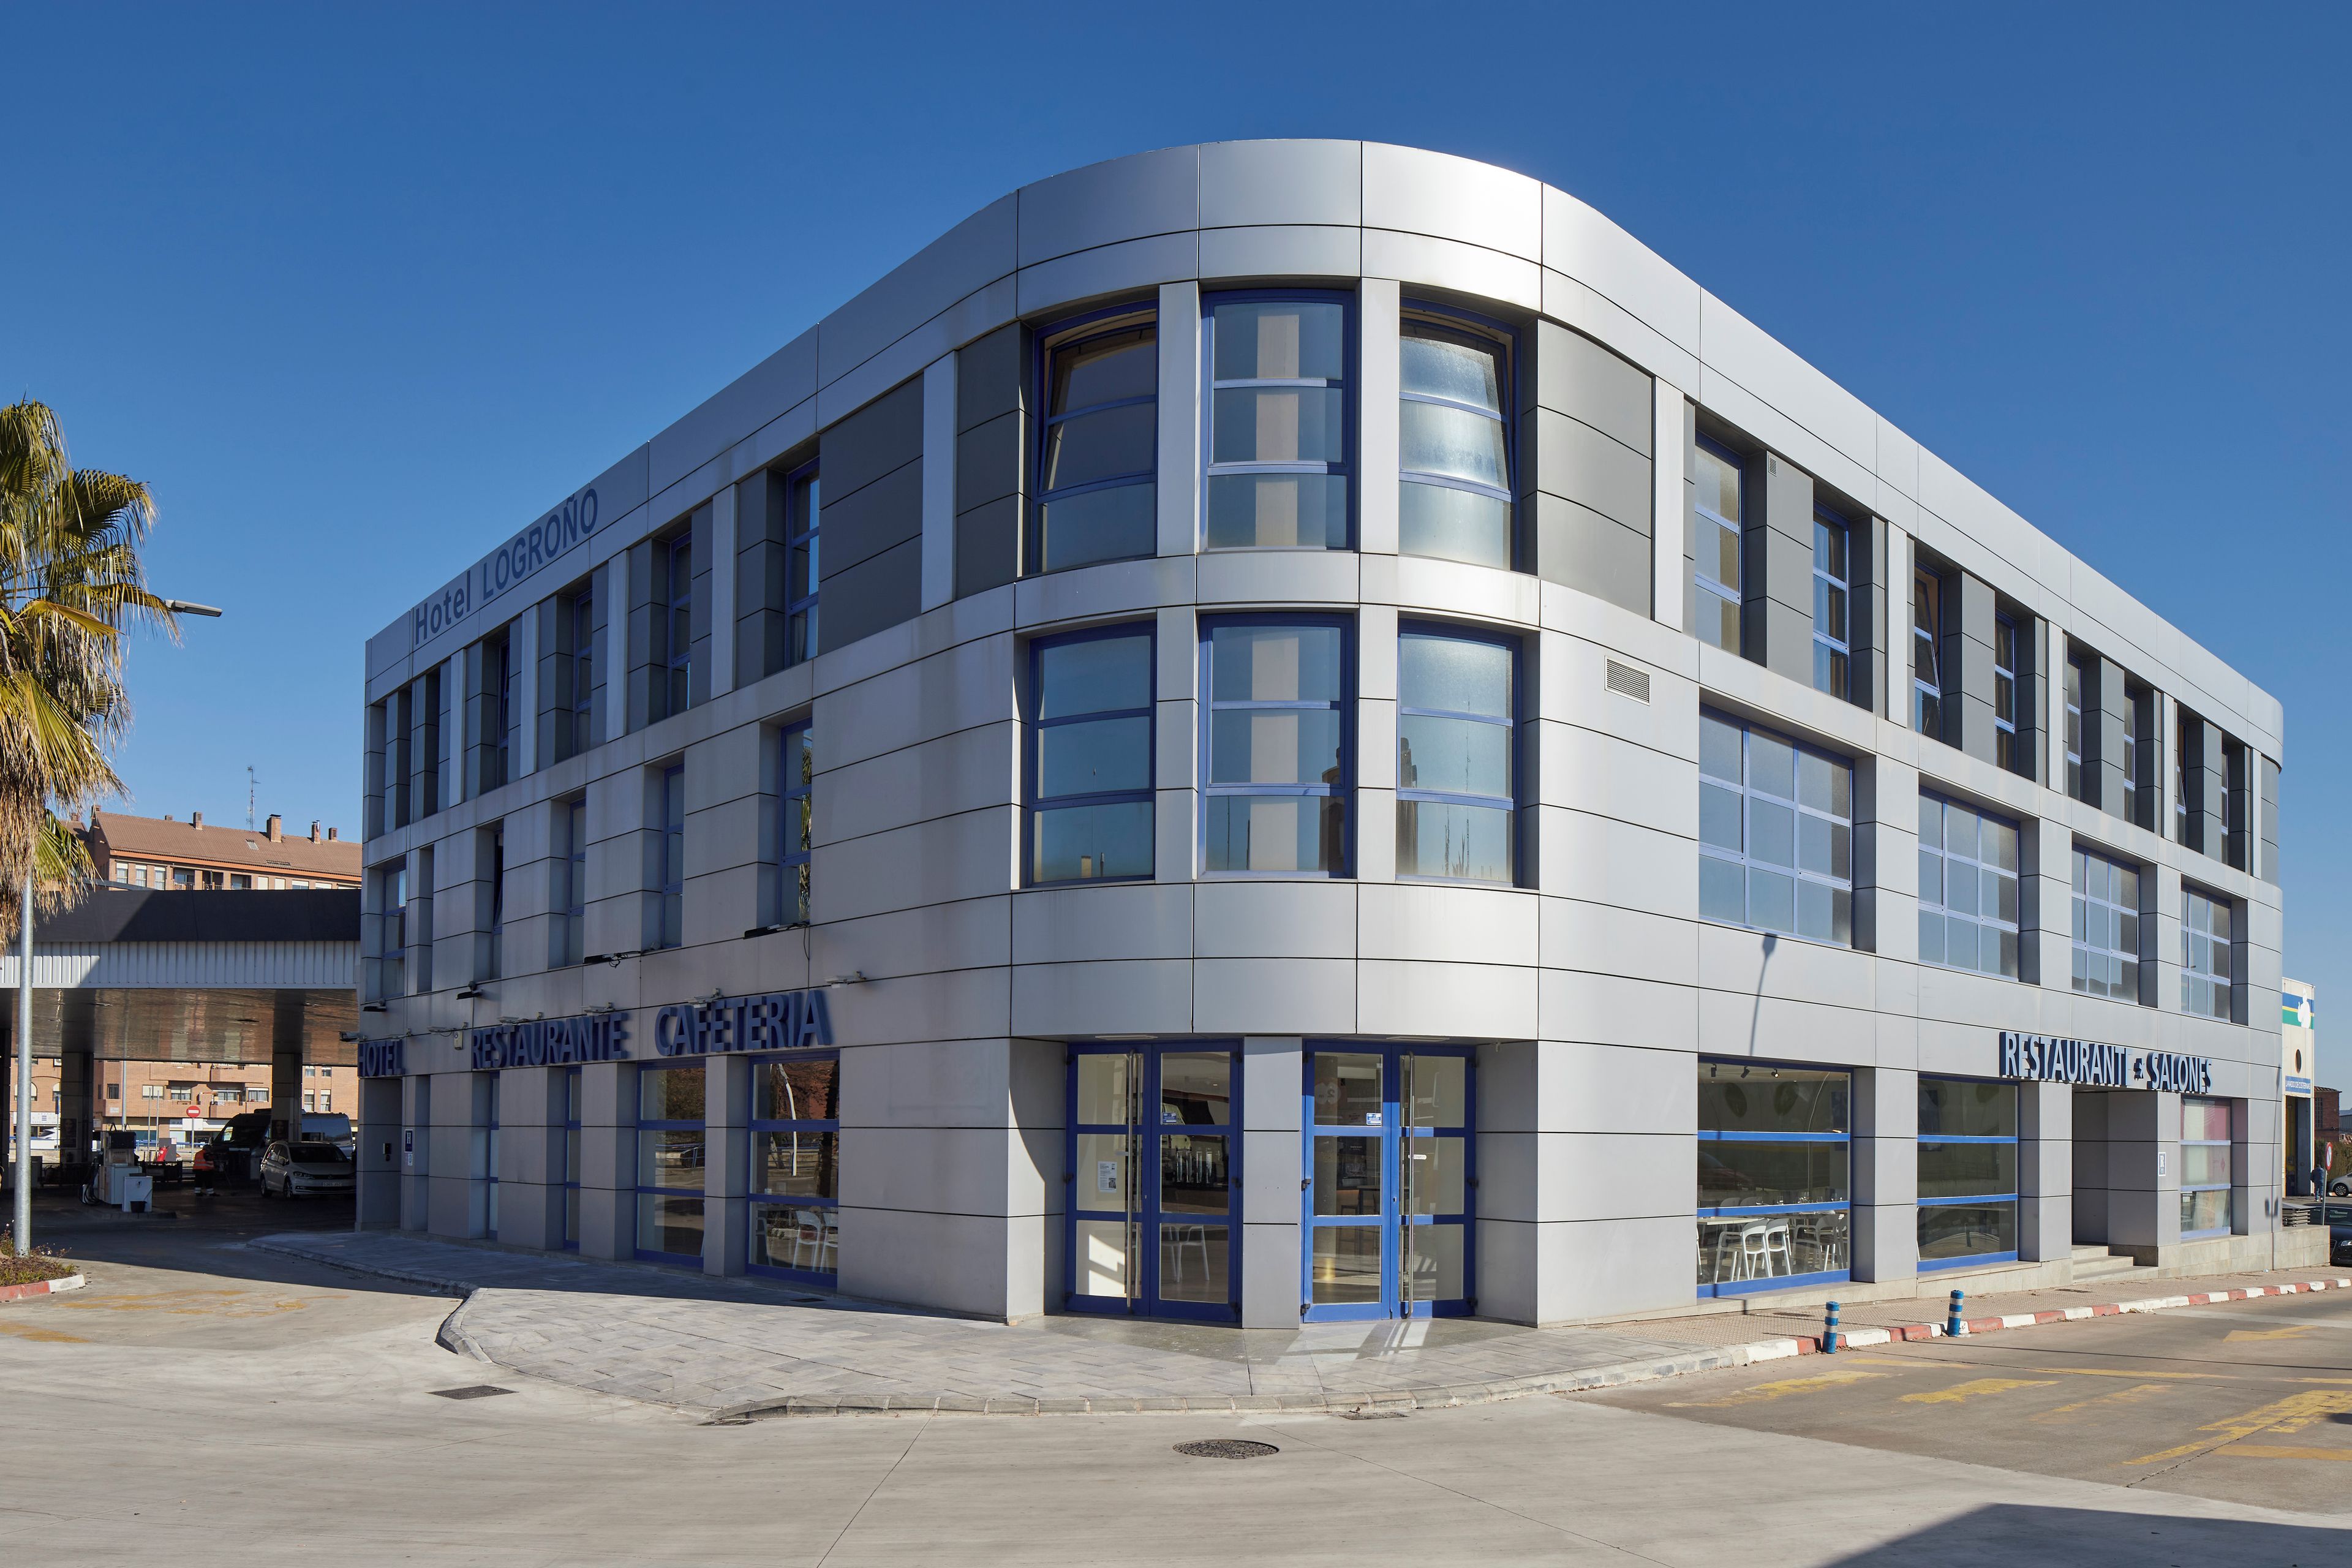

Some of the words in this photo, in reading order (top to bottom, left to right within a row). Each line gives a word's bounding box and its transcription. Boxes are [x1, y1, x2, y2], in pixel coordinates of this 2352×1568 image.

[415, 570, 471, 645] Hotel
[483, 488, 598, 601] LOGROÑO
[472, 1012, 629, 1069] RESTAURANTE
[654, 990, 831, 1056] CAFETERIA
[358, 1039, 405, 1077] HOTEL
[1999, 1031, 2133, 1087] RESTAURANTE
[2146, 1052, 2212, 1093] SALONES
[407, 1132, 412, 1144] H
[2160, 1155, 2165, 1167] R
